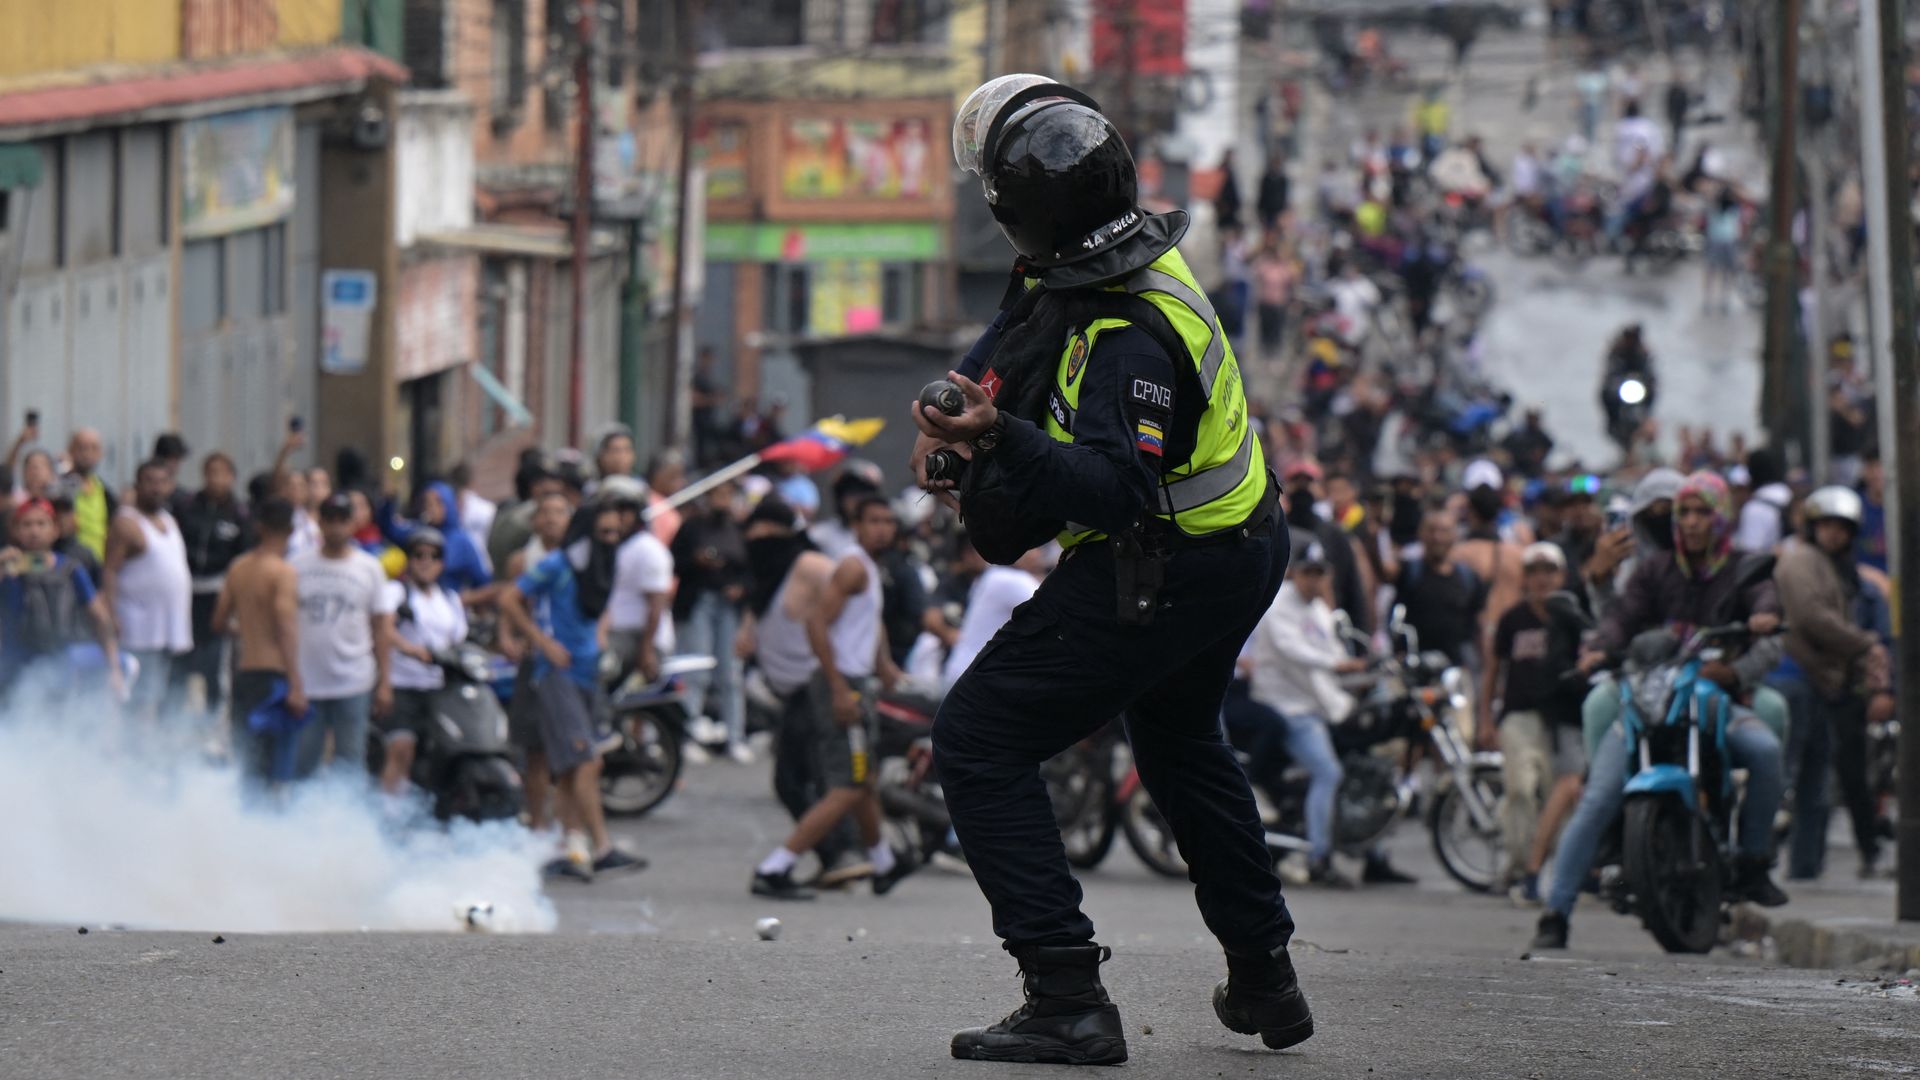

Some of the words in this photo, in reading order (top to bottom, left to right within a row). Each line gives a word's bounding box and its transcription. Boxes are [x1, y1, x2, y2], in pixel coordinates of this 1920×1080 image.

[1087, 234, 1104, 249] LA
[1115, 211, 1139, 232] VEGA
[1133, 379, 1172, 408] CPNB
